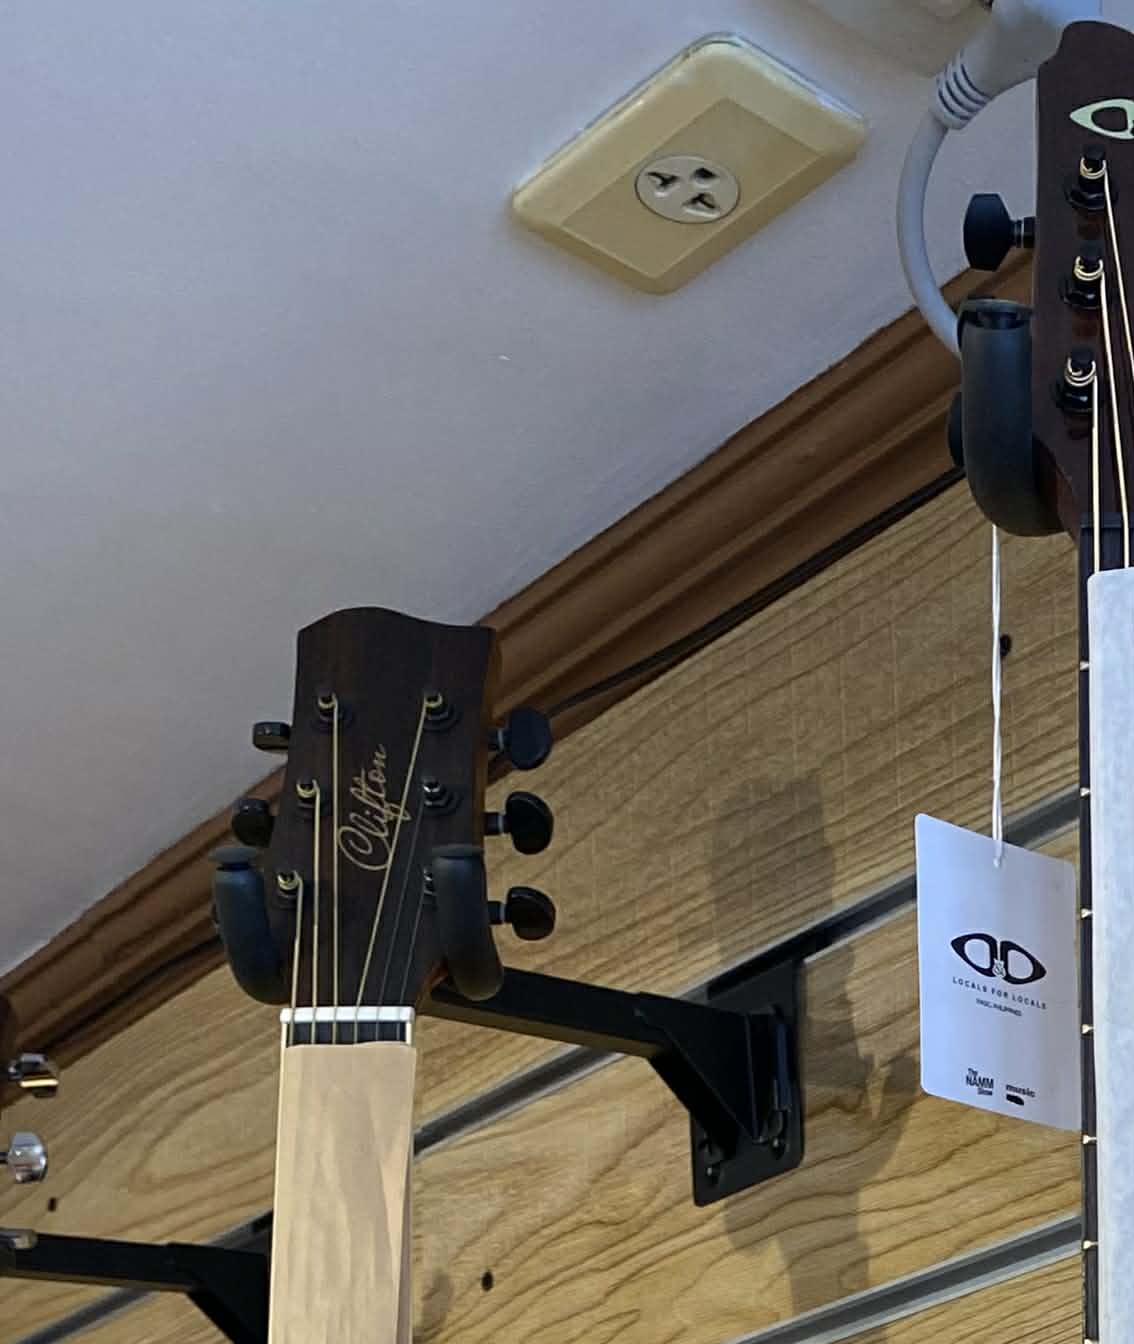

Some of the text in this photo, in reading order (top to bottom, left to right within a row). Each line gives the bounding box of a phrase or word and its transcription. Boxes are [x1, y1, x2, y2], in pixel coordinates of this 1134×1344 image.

[337, 743, 410, 871] Clifton
[952, 976, 987, 993] LOCALS
[991, 987, 1008, 999] FOR
[1012, 994, 1047, 1010] LOCALS
